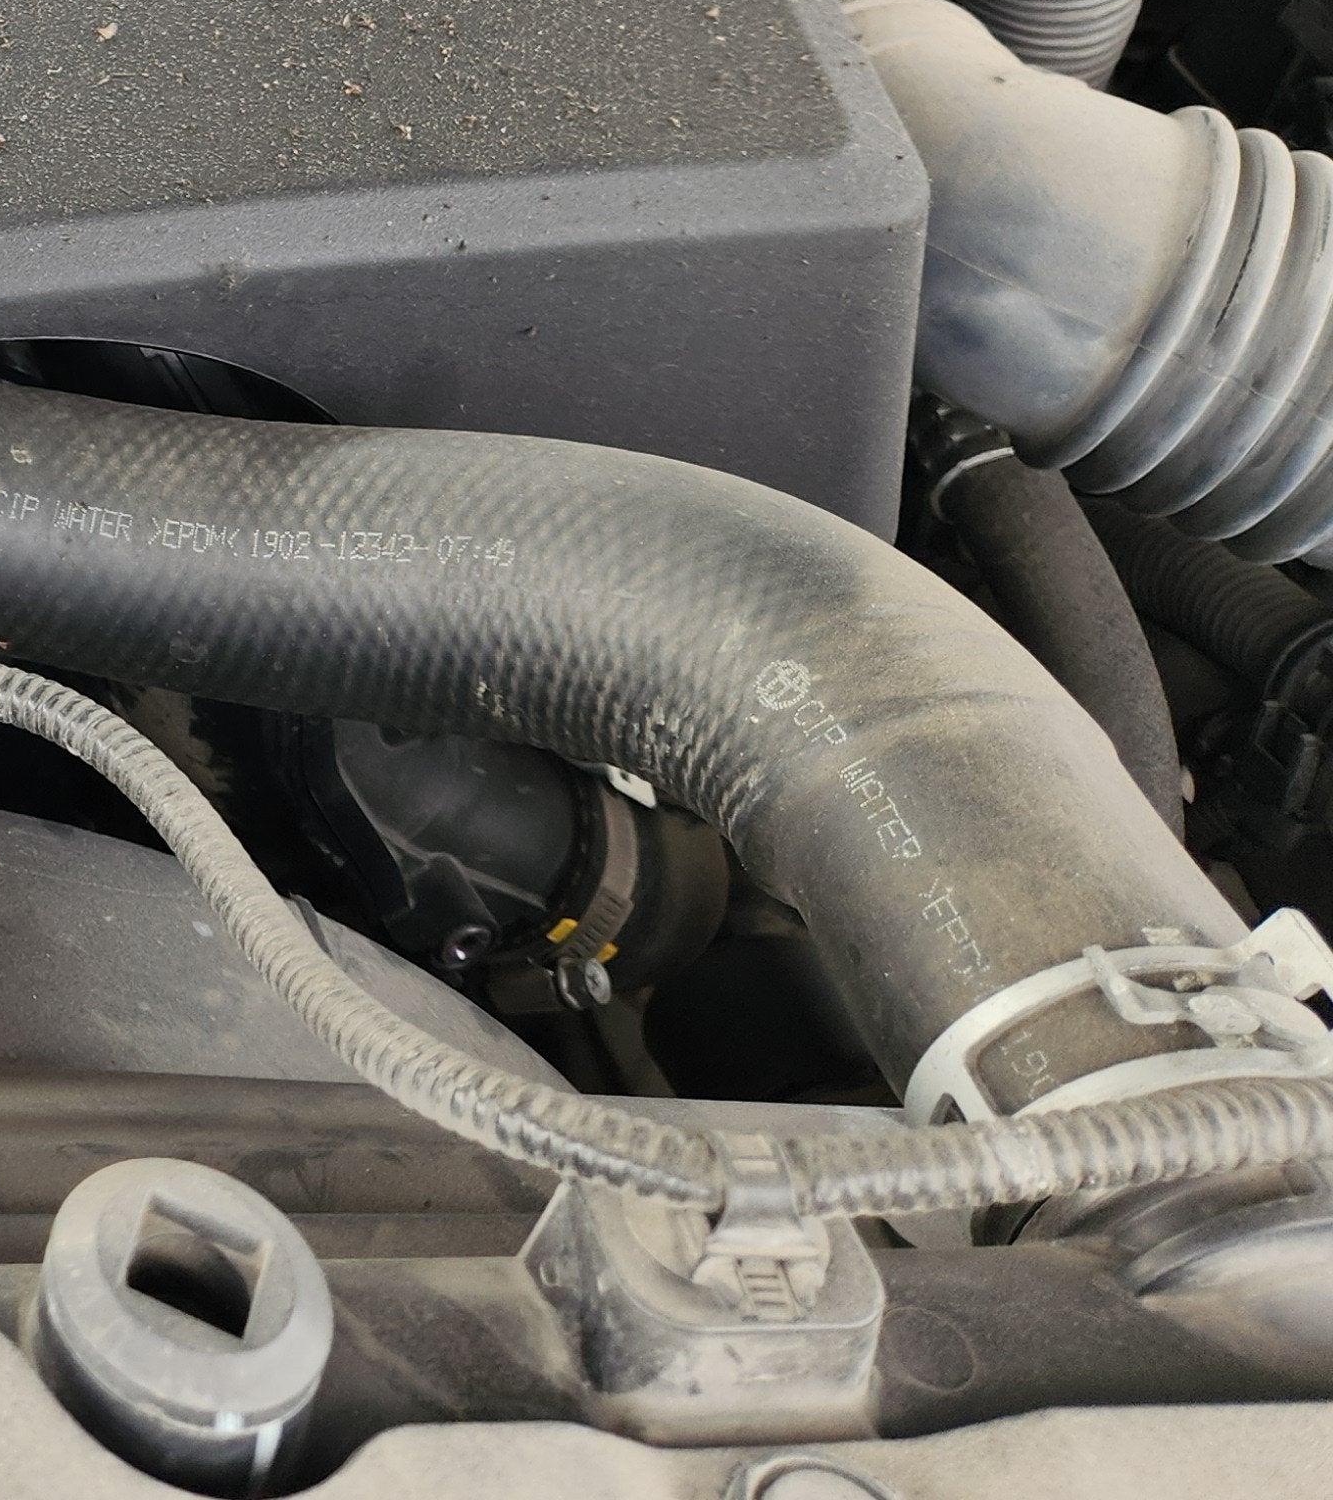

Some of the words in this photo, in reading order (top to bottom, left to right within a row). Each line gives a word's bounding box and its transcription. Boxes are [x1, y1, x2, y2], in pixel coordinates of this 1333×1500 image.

[52, 499, 133, 542] WATER
[793, 700, 847, 745] CIP
[839, 757, 922, 859] WATER
